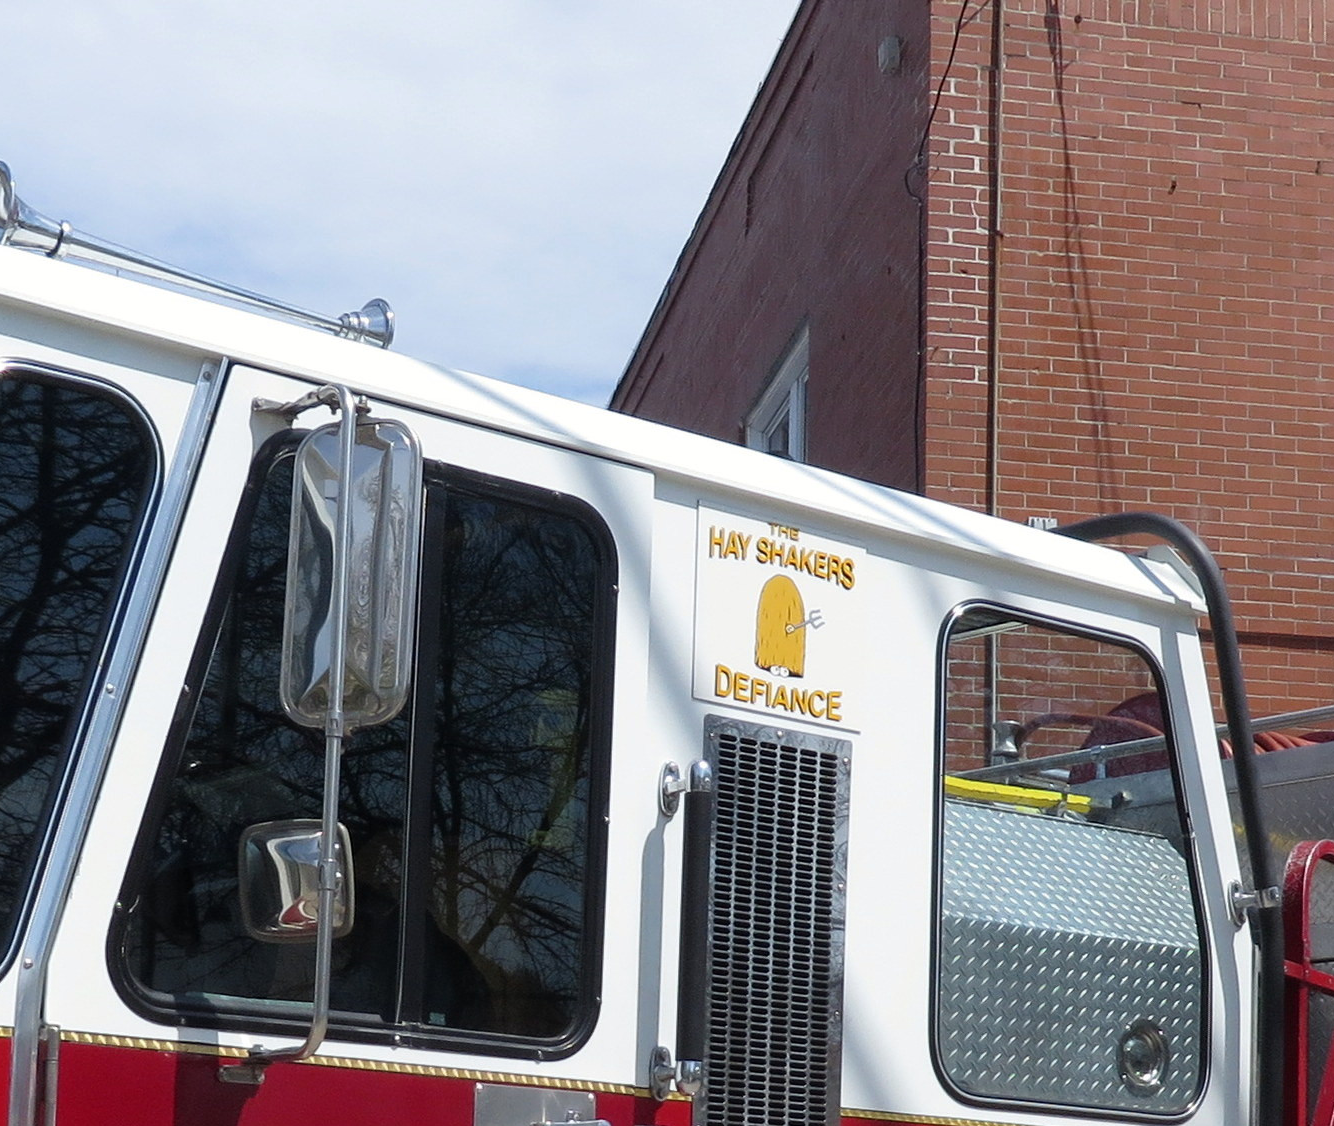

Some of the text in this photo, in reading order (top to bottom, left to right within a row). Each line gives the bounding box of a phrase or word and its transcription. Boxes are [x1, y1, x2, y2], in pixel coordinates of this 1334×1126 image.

[708, 525, 856, 590] HAY SHAKERS
[768, 522, 800, 542] THE
[714, 663, 843, 722] DEFIANCE
